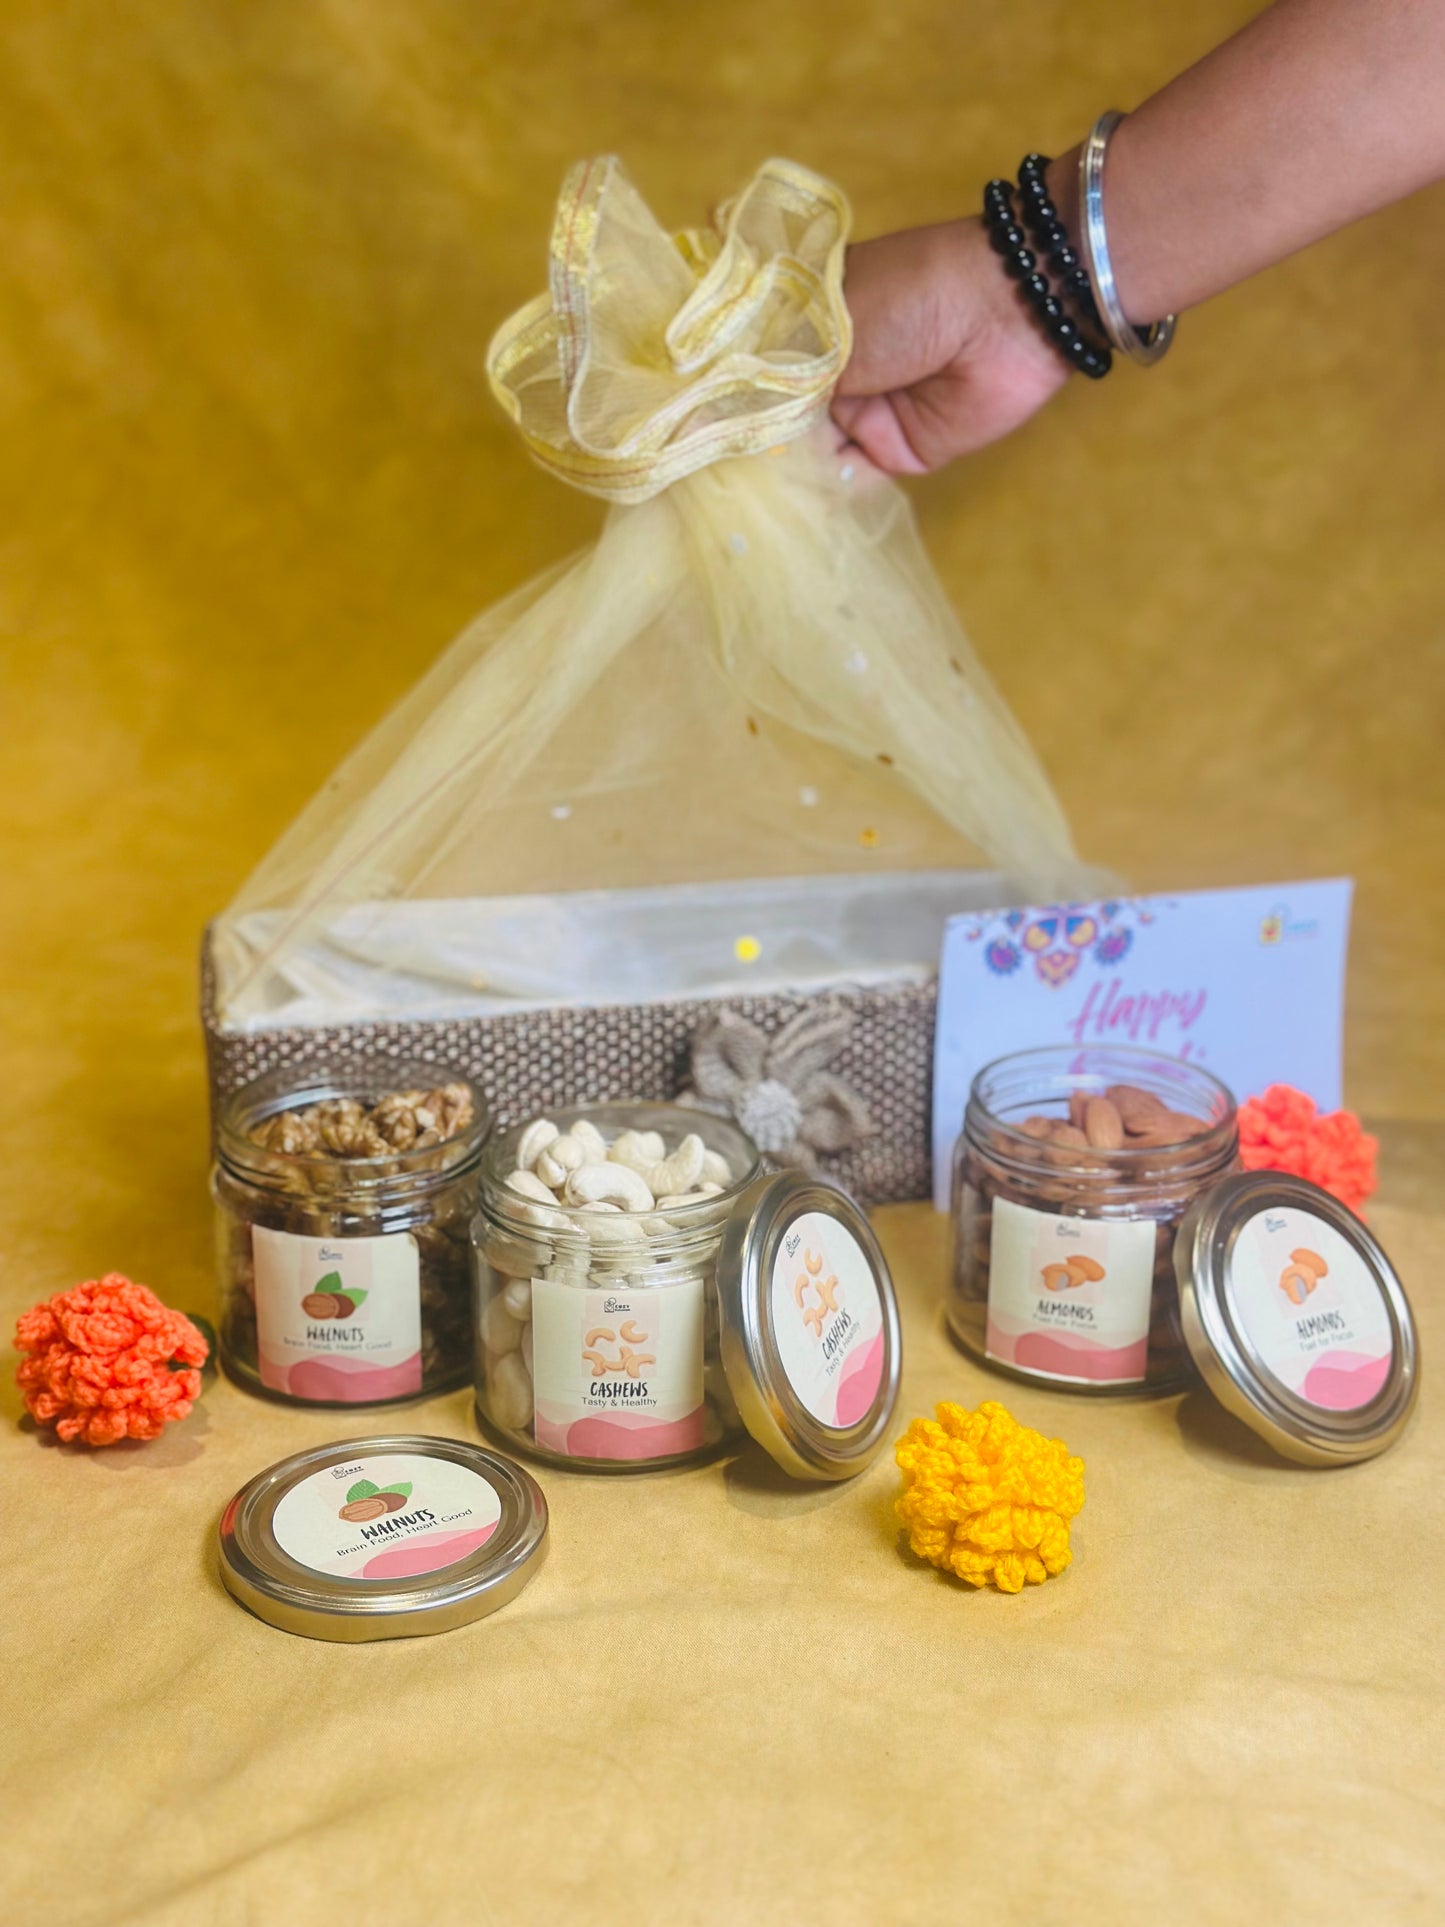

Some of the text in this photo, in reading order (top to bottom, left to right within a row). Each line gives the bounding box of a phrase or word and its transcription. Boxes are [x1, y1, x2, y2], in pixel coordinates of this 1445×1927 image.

[1070, 979, 1207, 1046] Happy
[1038, 1299, 1095, 1322] ALMONDS
[306, 1325, 364, 1341] WALNUTS
[822, 1307, 852, 1360] CASHEWS
[1296, 1311, 1345, 1339] ALMONDS
[826, 1357, 841, 1376] Tasty
[590, 1381, 648, 1398] CASHEWS
[581, 1397, 658, 1408] Tasty & Healthy
[337, 1508, 473, 1557] Brain Food, Heart Good
[360, 1508, 435, 1540] WALNUTS
